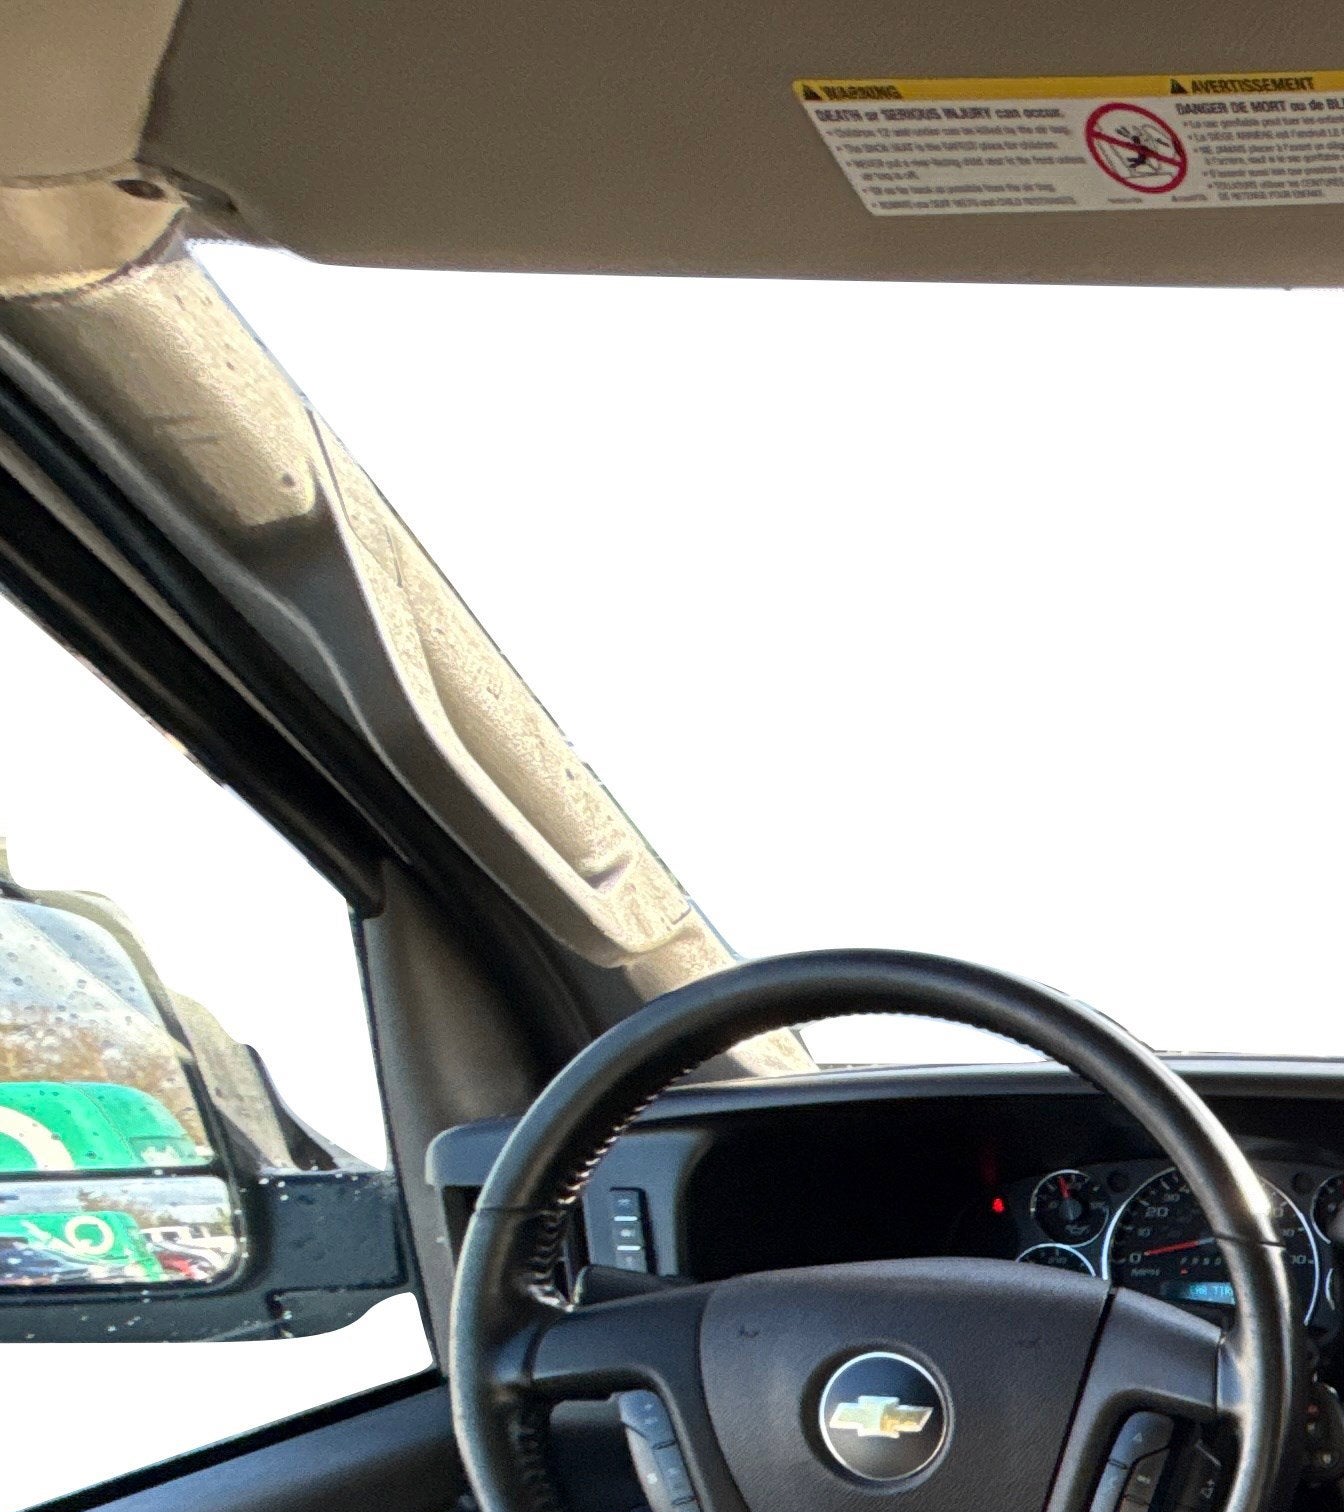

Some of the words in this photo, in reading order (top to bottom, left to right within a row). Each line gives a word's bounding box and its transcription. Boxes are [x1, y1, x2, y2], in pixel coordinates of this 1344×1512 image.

[1191, 77, 1315, 95] AVERTISSEMENT
[1175, 101, 1228, 115] DANGER
[1229, 100, 1249, 113] DE
[1249, 99, 1287, 112] MORT
[1288, 98, 1307, 111] ou
[1306, 97, 1325, 110] de
[813, 108, 864, 121] DEATH
[878, 107, 942, 120] SERIOUS
[940, 107, 994, 120] INJURY
[992, 107, 1022, 119] can
[1145, 1206, 1169, 1218] 20
[1129, 1252, 1141, 1263] 0
